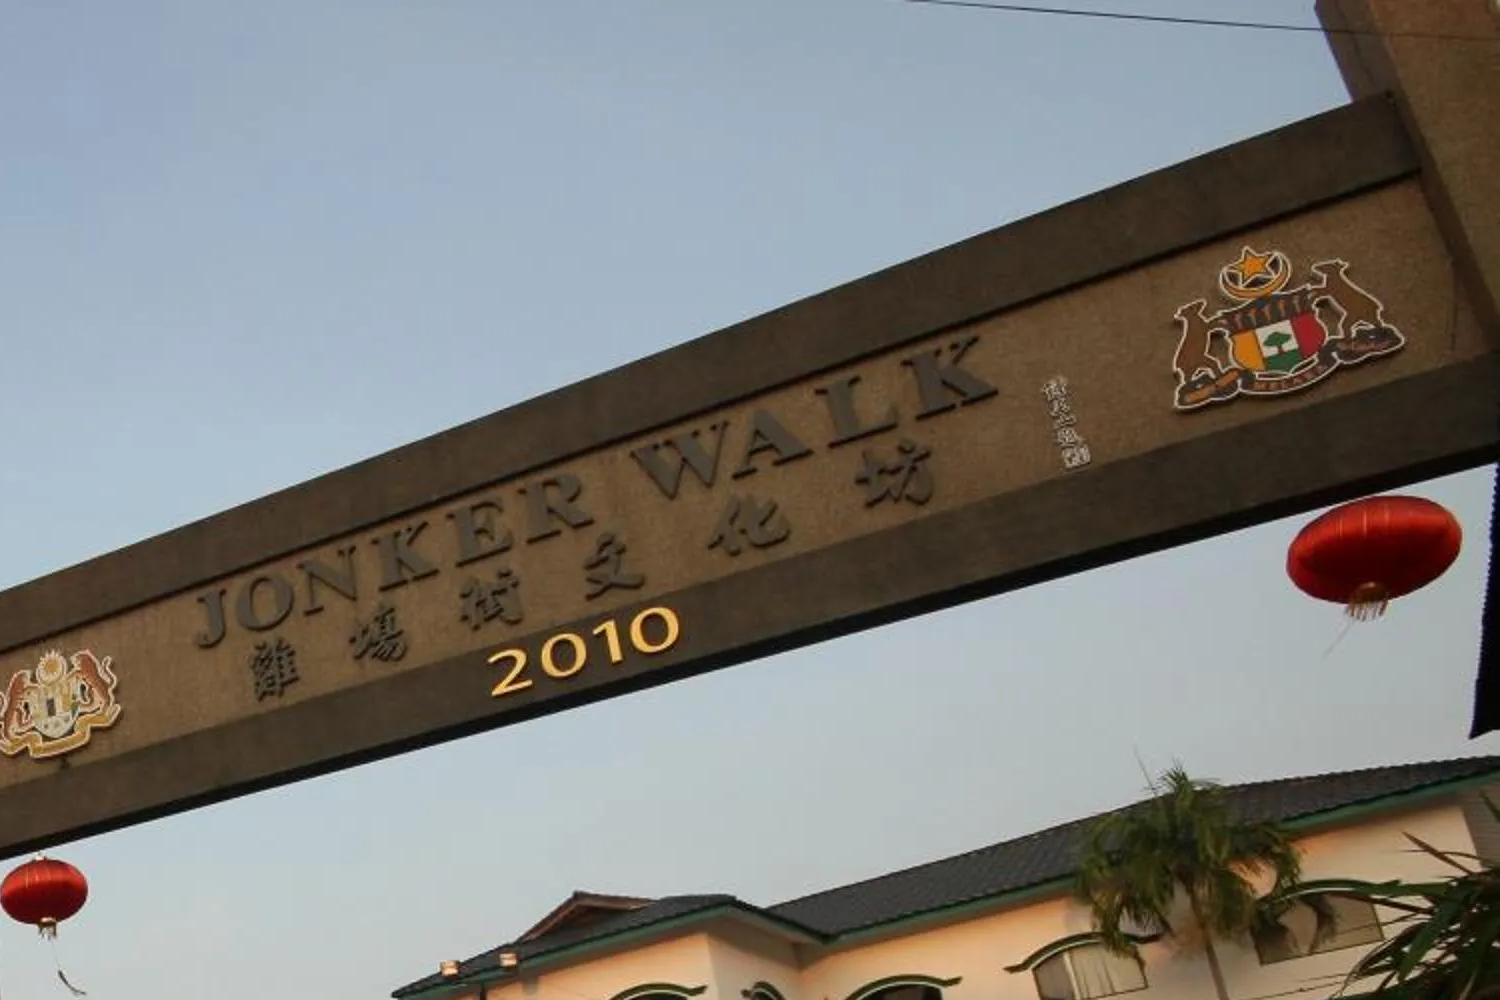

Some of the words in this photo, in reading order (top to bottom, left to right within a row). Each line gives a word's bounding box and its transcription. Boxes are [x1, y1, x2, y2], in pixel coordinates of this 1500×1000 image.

[192, 471, 595, 650] JONKER
[629, 335, 1000, 500] WALK
[486, 605, 681, 697] 2010
